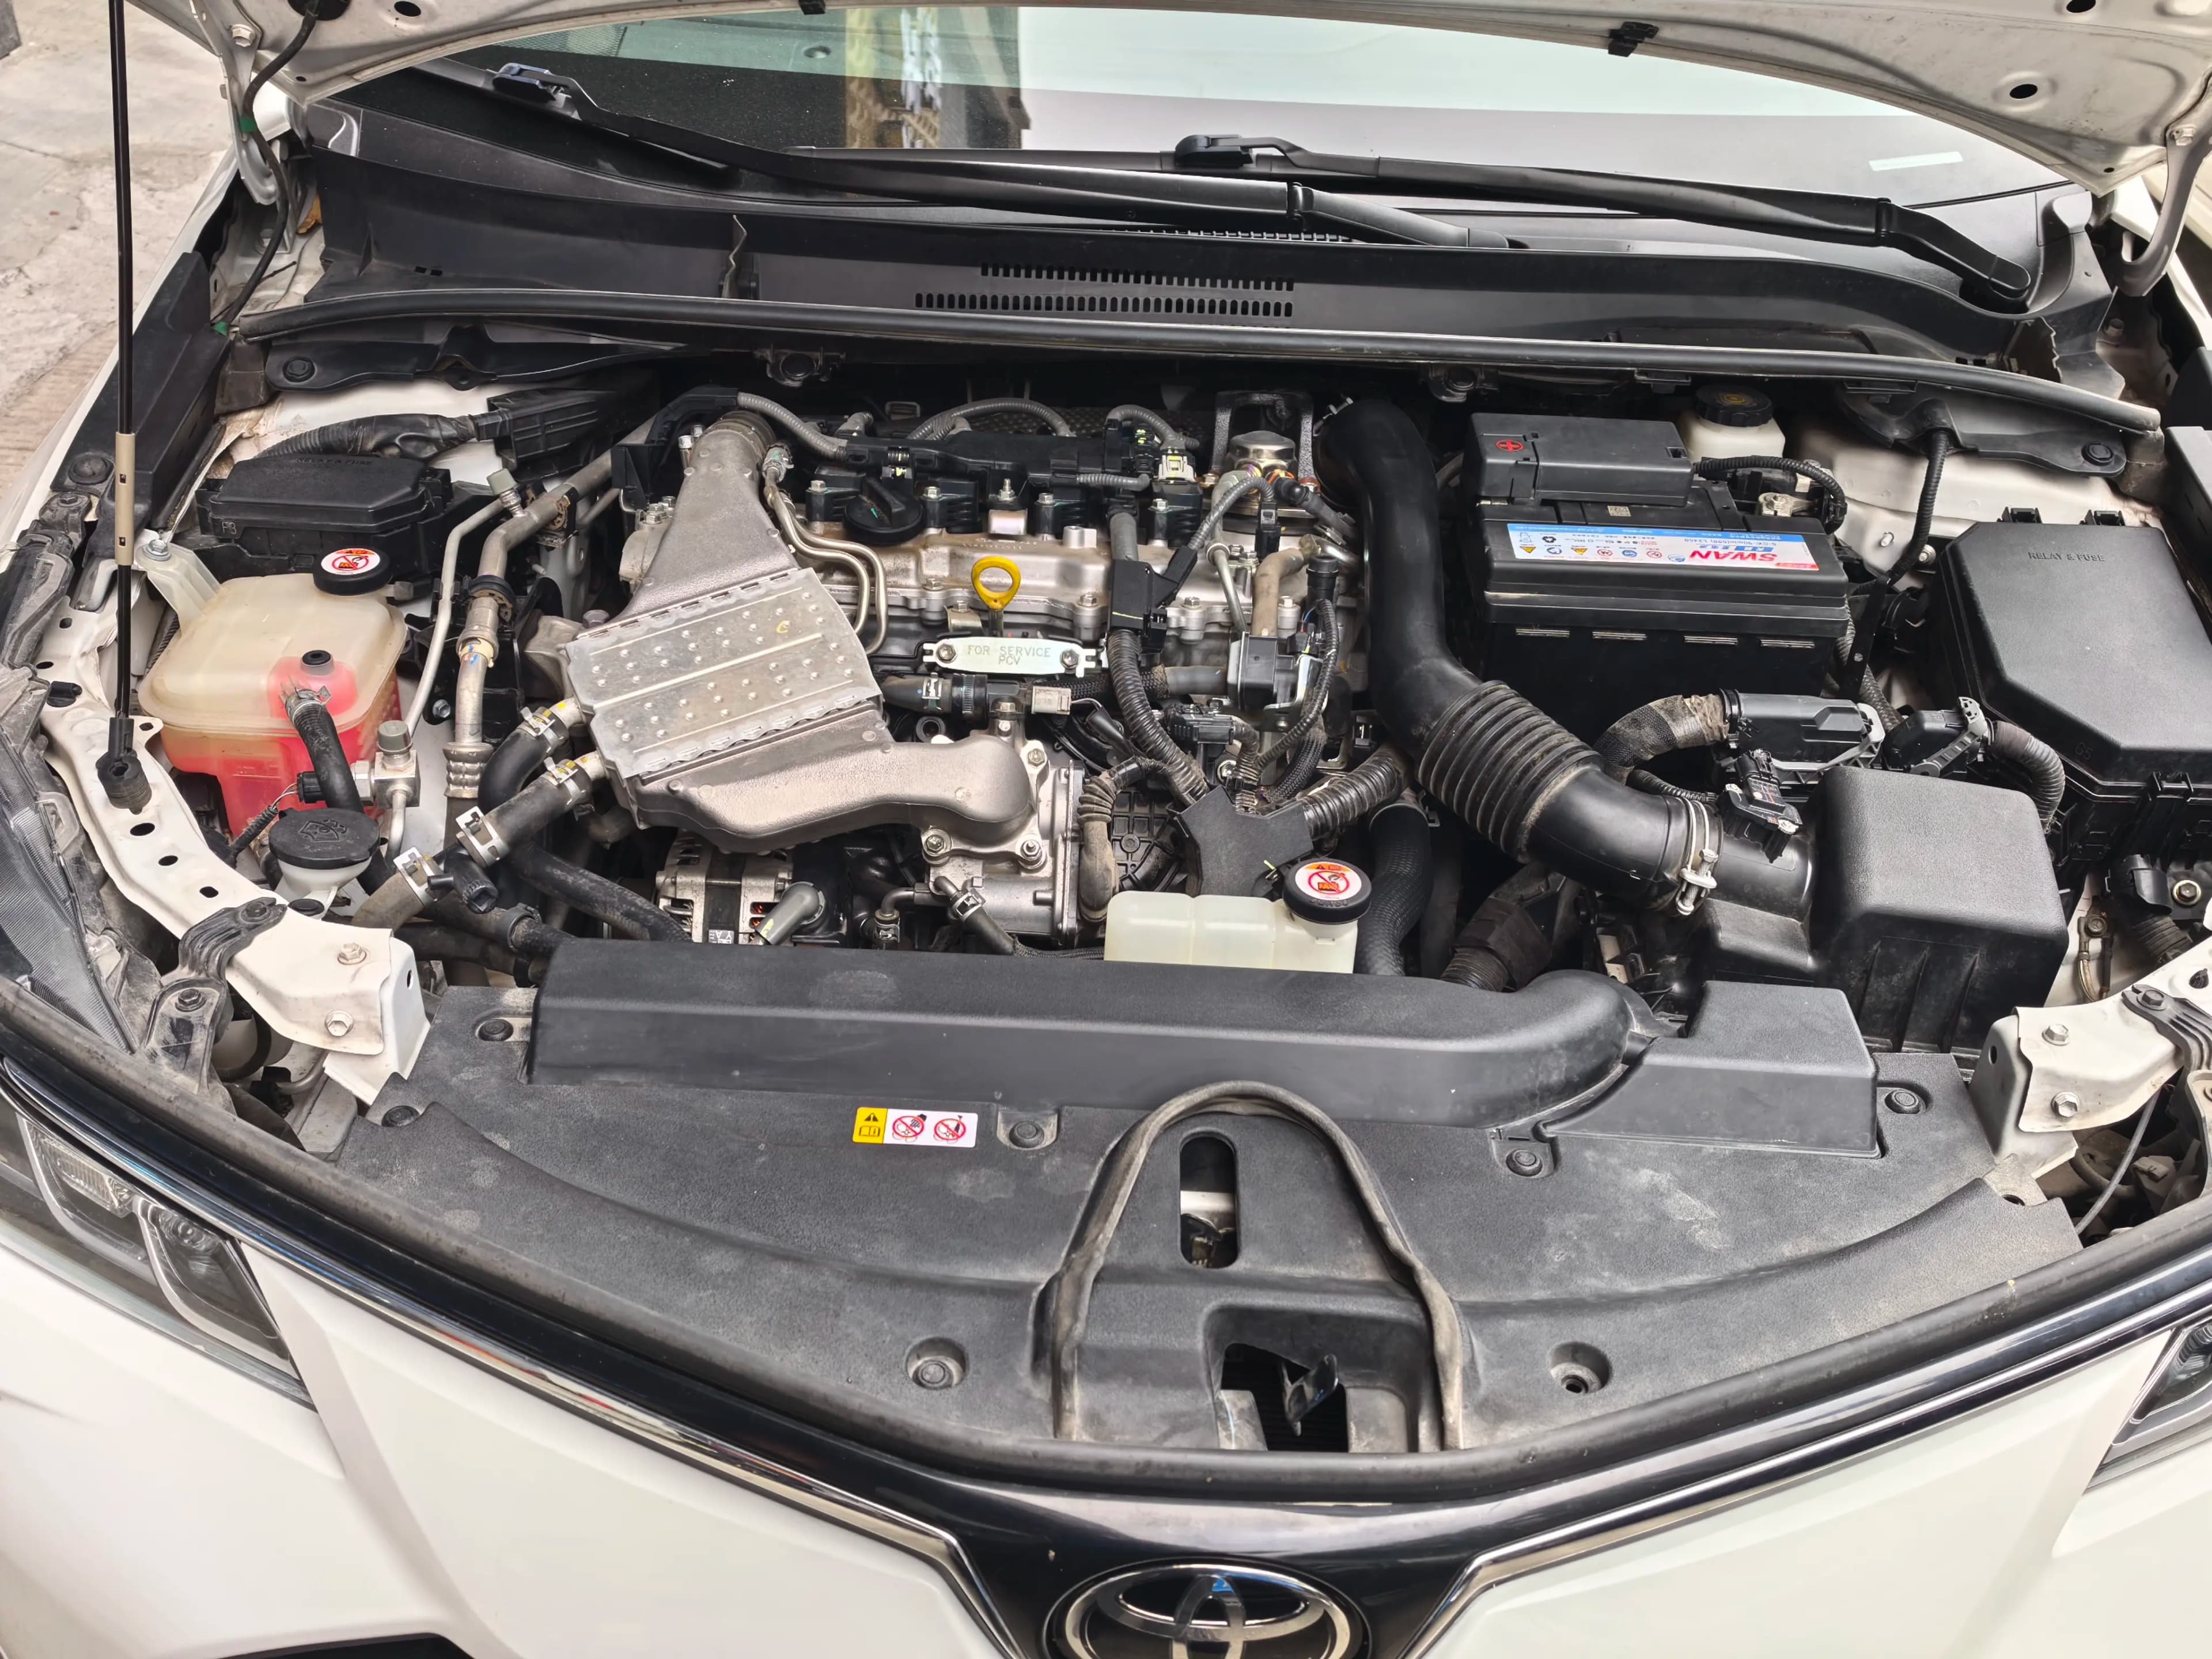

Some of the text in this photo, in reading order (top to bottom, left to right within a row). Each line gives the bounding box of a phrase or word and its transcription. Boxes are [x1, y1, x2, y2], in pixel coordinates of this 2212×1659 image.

[222, 521, 237, 535] F3
[1689, 550, 1778, 562] SWAN
[2028, 551, 2062, 560] RELAY
[2076, 554, 2107, 562] FUSE
[967, 645, 1051, 657] FOR SERVICE
[998, 655, 1021, 665] PCV
[2075, 741, 2094, 760] G5
